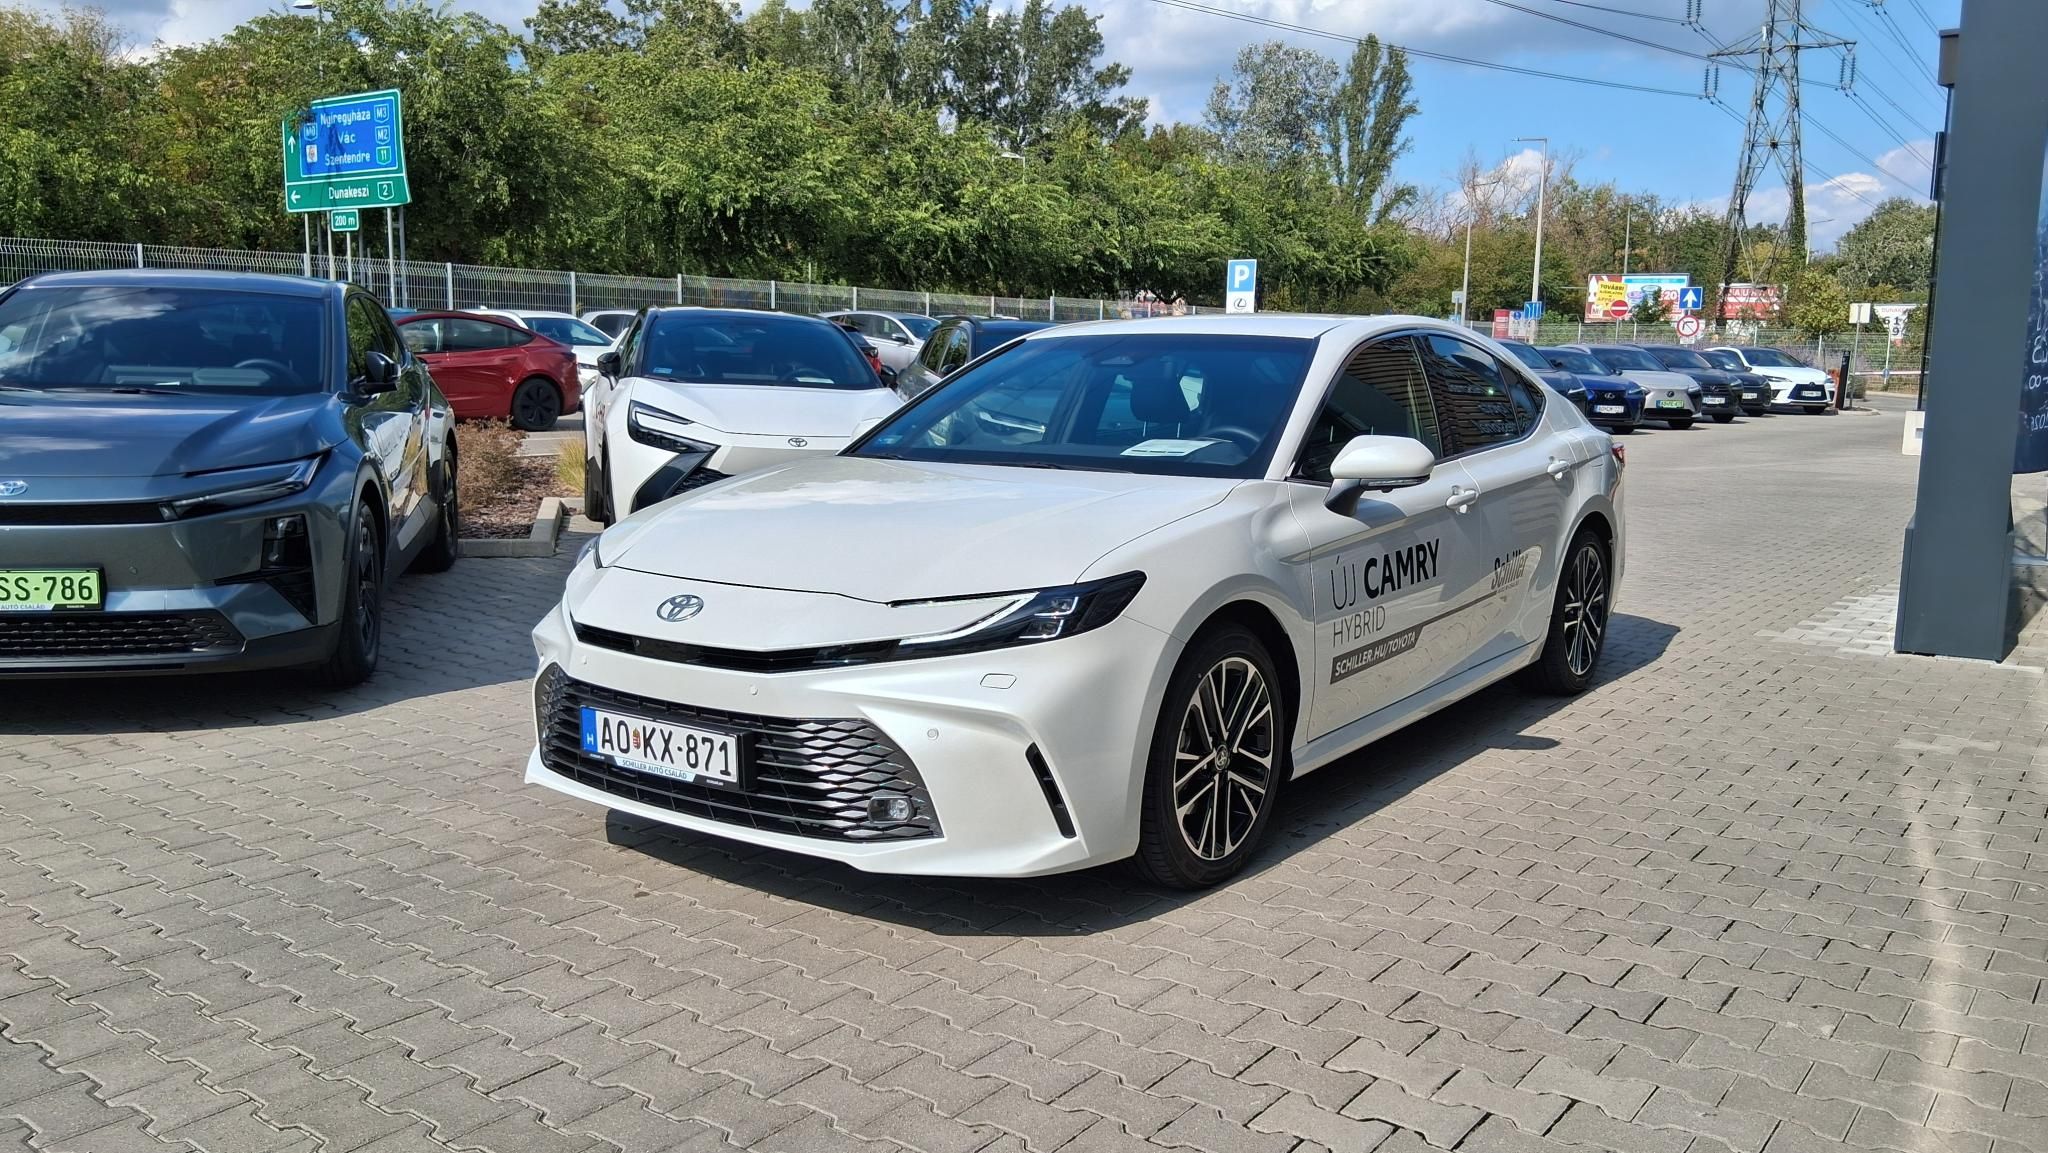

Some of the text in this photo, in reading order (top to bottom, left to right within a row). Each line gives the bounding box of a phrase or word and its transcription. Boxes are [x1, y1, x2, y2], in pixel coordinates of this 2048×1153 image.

[320, 108, 387, 128] Nyíregyháza M3
[337, 129, 388, 144] Vác M2
[324, 150, 388, 167] Szentendre 11
[328, 184, 389, 199] Dunakeszi 2
[334, 216, 356, 227] 200 m
[1234, 264, 1250, 289] P
[1330, 538, 1440, 611] ÚJ CAMRY
[1490, 548, 1529, 590] Schiller
[1333, 605, 1386, 649] HYBRID
[1334, 631, 1416, 678] SCHILLER.HU/TOYOTA
[586, 733, 595, 746] H
[601, 717, 732, 777] AO KX-871
[622, 758, 687, 780] SCHILLER AUTÓ CSALÁD
